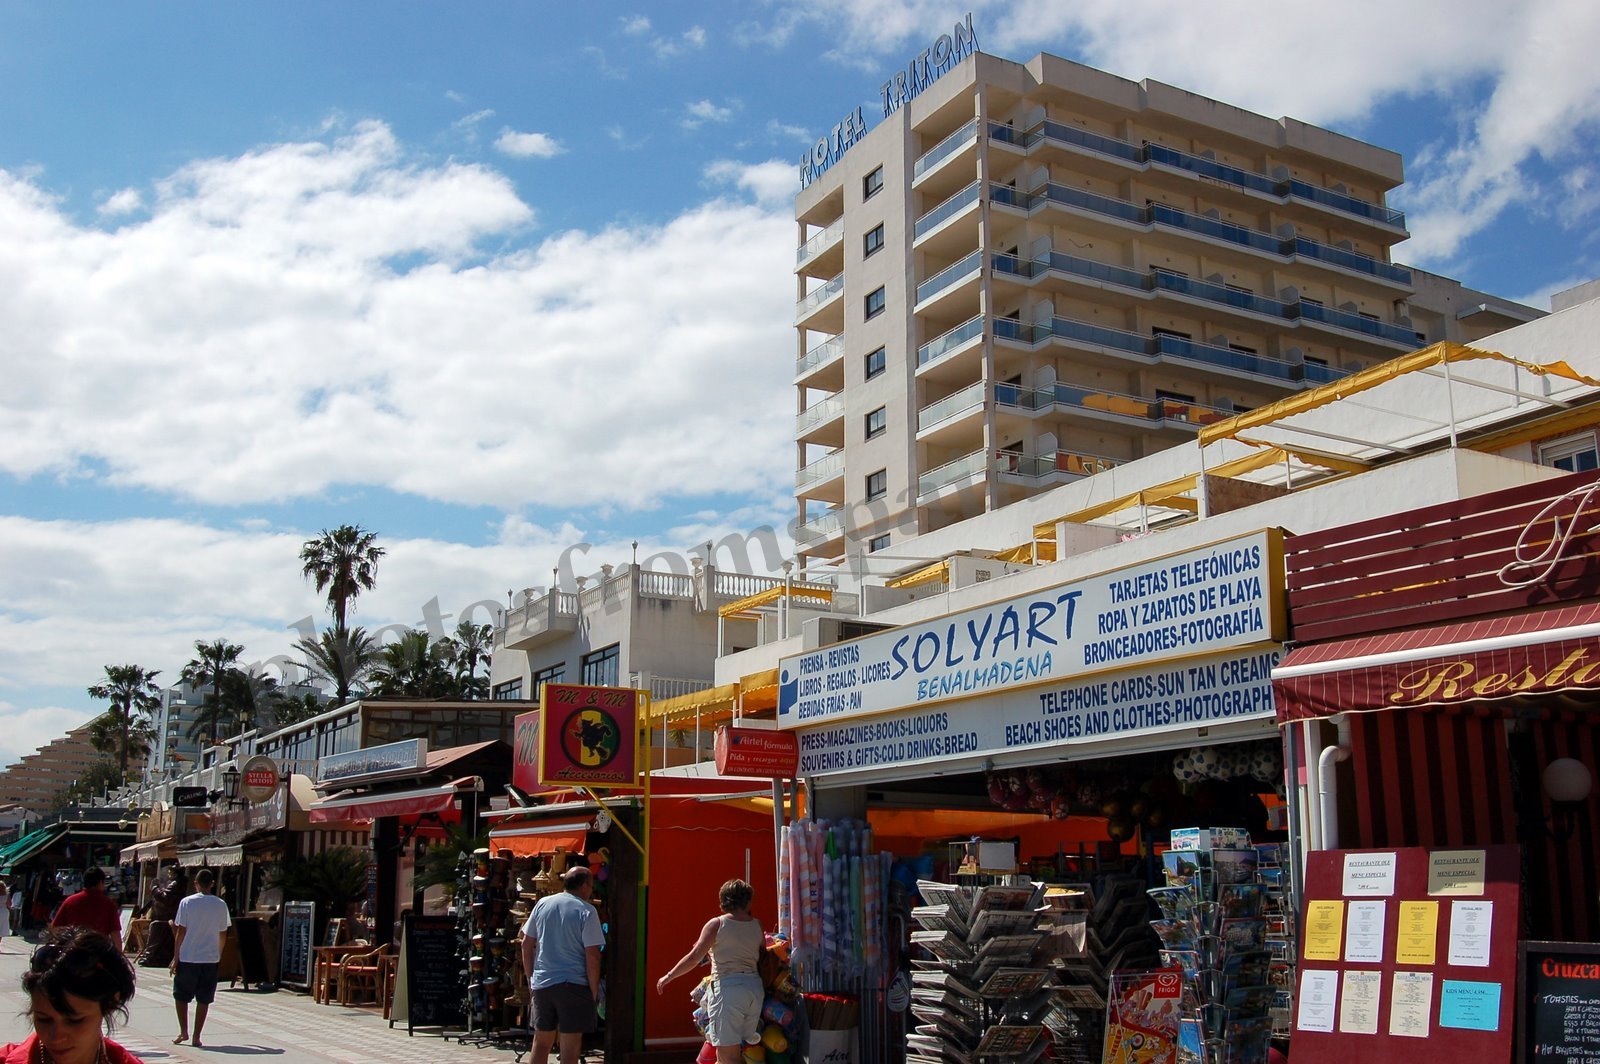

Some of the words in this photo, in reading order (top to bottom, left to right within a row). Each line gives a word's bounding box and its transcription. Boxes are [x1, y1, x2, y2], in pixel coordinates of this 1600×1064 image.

[800, 106, 866, 181] HOTEL
[880, 12, 973, 111] TRITON
[1109, 569, 1168, 604] TARJETAS
[1171, 545, 1260, 588] TELEFÓNICAS
[1098, 608, 1128, 635] ROPA
[1131, 605, 1140, 627] Y
[1142, 592, 1196, 625] ZAPATOS
[1199, 587, 1218, 612] DE
[1220, 576, 1262, 607] PLAYA
[891, 590, 1082, 680] SOLYART
[1084, 603, 1264, 666] BRONCEADORES-FOTOGRAFÍA
[799, 677, 822, 697] LIBROS
[826, 669, 857, 692] REGALOS
[861, 661, 891, 685] LICORES
[800, 656, 824, 675] PRENSA
[829, 645, 860, 666] REVISTAS
[917, 650, 1053, 700] BENALMADENA
[555, 688, 580, 705] M
[586, 690, 598, 705] &
[603, 692, 628, 708] M
[1040, 683, 1108, 715] TELEPHONE
[1111, 671, 1185, 704] CARDS-SUN
[1188, 664, 1217, 691] TAN
[1220, 652, 1280, 687] CREAMS
[799, 699, 825, 719] BEBIDAS
[826, 691, 846, 715] FRÍAS
[850, 691, 862, 710] PAN
[740, 735, 763, 747] Airtel
[801, 712, 948, 751] PRESS-MAGAZINES-BOOKS-LIQUORS
[1005, 725, 1041, 747] BEACH
[1044, 715, 1082, 740] SHOES
[1085, 709, 1109, 735] AND
[729, 752, 745, 761] Pida
[801, 751, 845, 773] SOUVENIRS
[847, 750, 853, 766] &
[855, 742, 905, 766] GIFTS-COLD
[907, 731, 978, 761] DRINKS-BREAD
[553, 766, 626, 781] Accesorios
[1542, 957, 1600, 980] Cruzca
